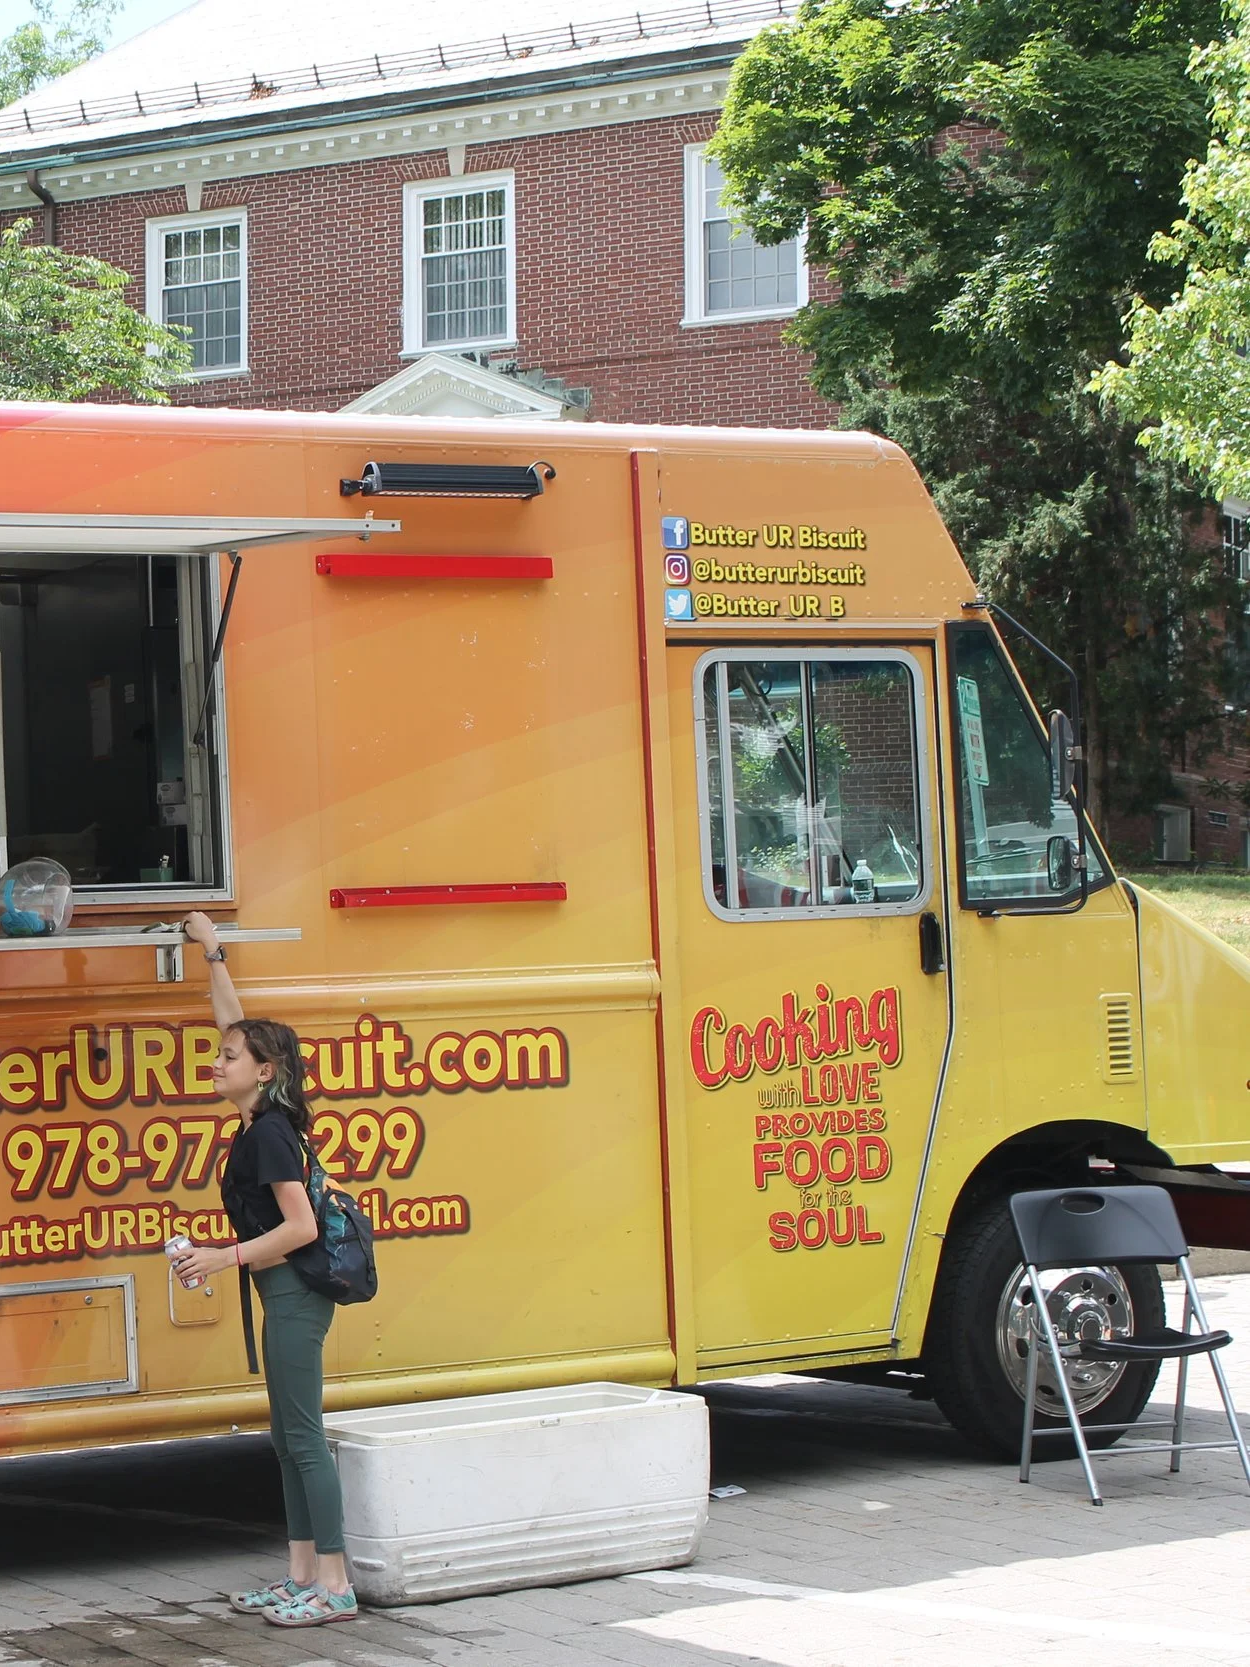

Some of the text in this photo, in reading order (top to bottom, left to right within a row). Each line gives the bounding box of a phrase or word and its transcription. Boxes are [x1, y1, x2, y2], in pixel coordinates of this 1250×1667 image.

[690, 522, 757, 547] Butter
[762, 525, 794, 547] UR
[799, 526, 866, 550] Biscuit
[692, 559, 865, 585] @butterurbiscuit
[690, 982, 901, 1090] Cooking
[758, 1062, 881, 1108] with LOVE
[754, 1108, 886, 1140] PROVIDES
[6, 1110, 418, 1193] 978-97299
[752, 1135, 892, 1190] FOOD
[799, 1184, 851, 1208] for the
[768, 1204, 884, 1251] SOUL
